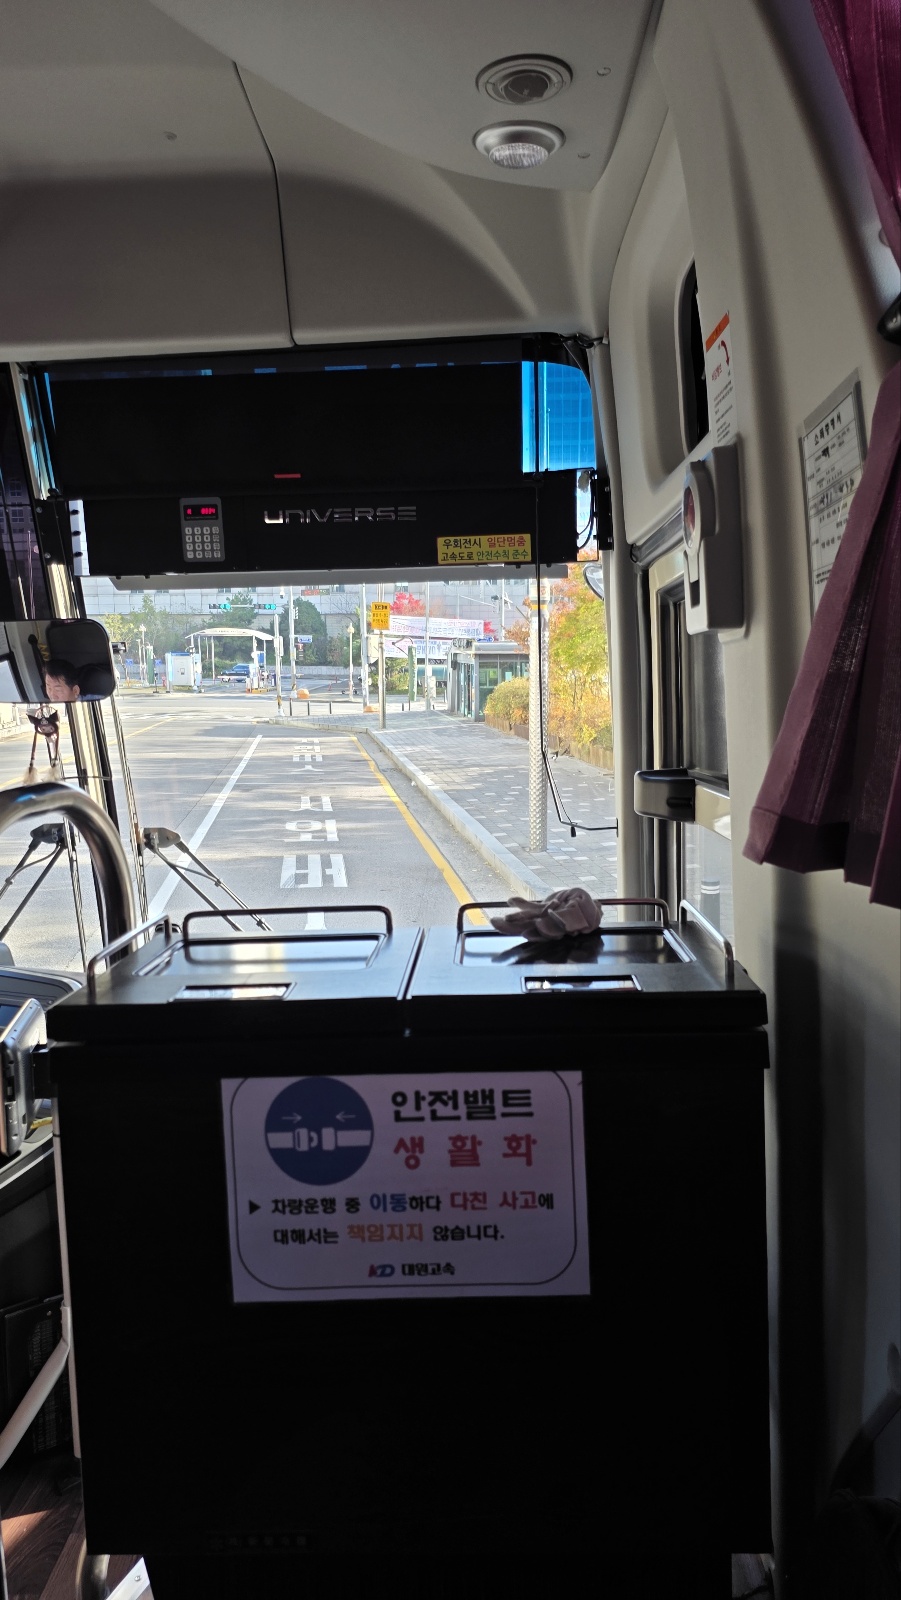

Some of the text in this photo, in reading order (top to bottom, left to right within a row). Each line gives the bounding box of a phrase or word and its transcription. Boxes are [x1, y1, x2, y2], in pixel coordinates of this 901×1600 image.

[263, 506, 417, 524] UNIVERSE
[442, 536, 526, 549] 우회전시 일단멈춤
[441, 549, 529, 562] 고속도로 안전수칙 준수
[391, 1088, 534, 1123] 안전밸트
[271, 1191, 554, 1215] 차량운행 중 이동하다 다친 사고에
[273, 1223, 505, 1245] 대해서는 책임지지 않습니다.
[401, 1262, 455, 1276] 대원고속
